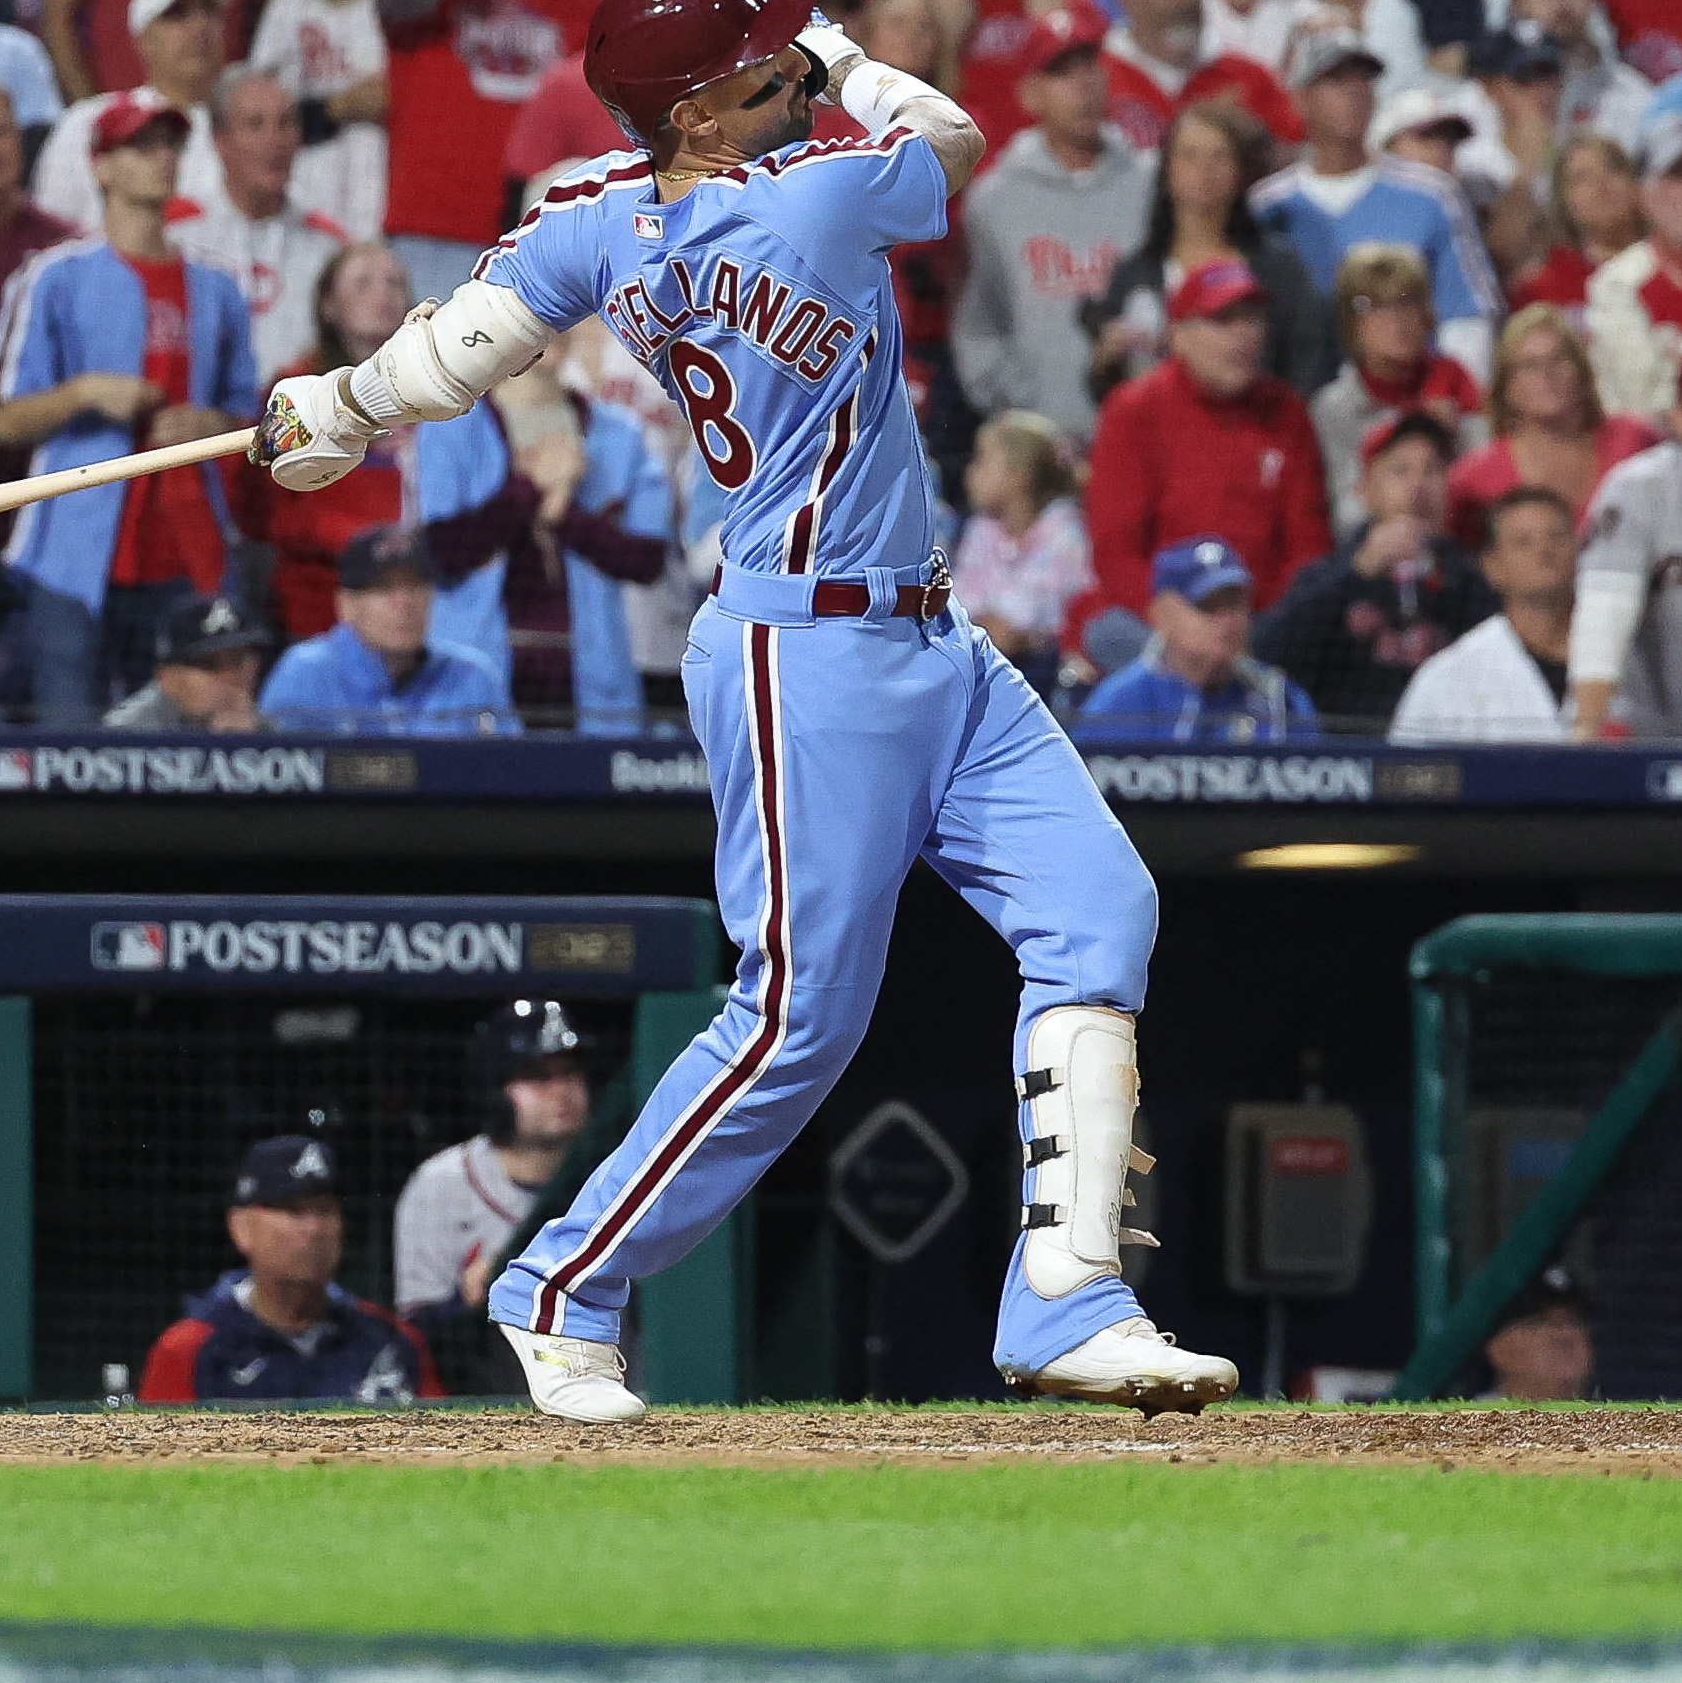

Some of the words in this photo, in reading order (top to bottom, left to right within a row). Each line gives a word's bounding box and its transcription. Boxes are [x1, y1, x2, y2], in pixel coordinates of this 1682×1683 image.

[667, 335, 758, 493] 8
[34, 747, 325, 792] POSTSEASON
[168, 921, 523, 973] POSTSEASON
